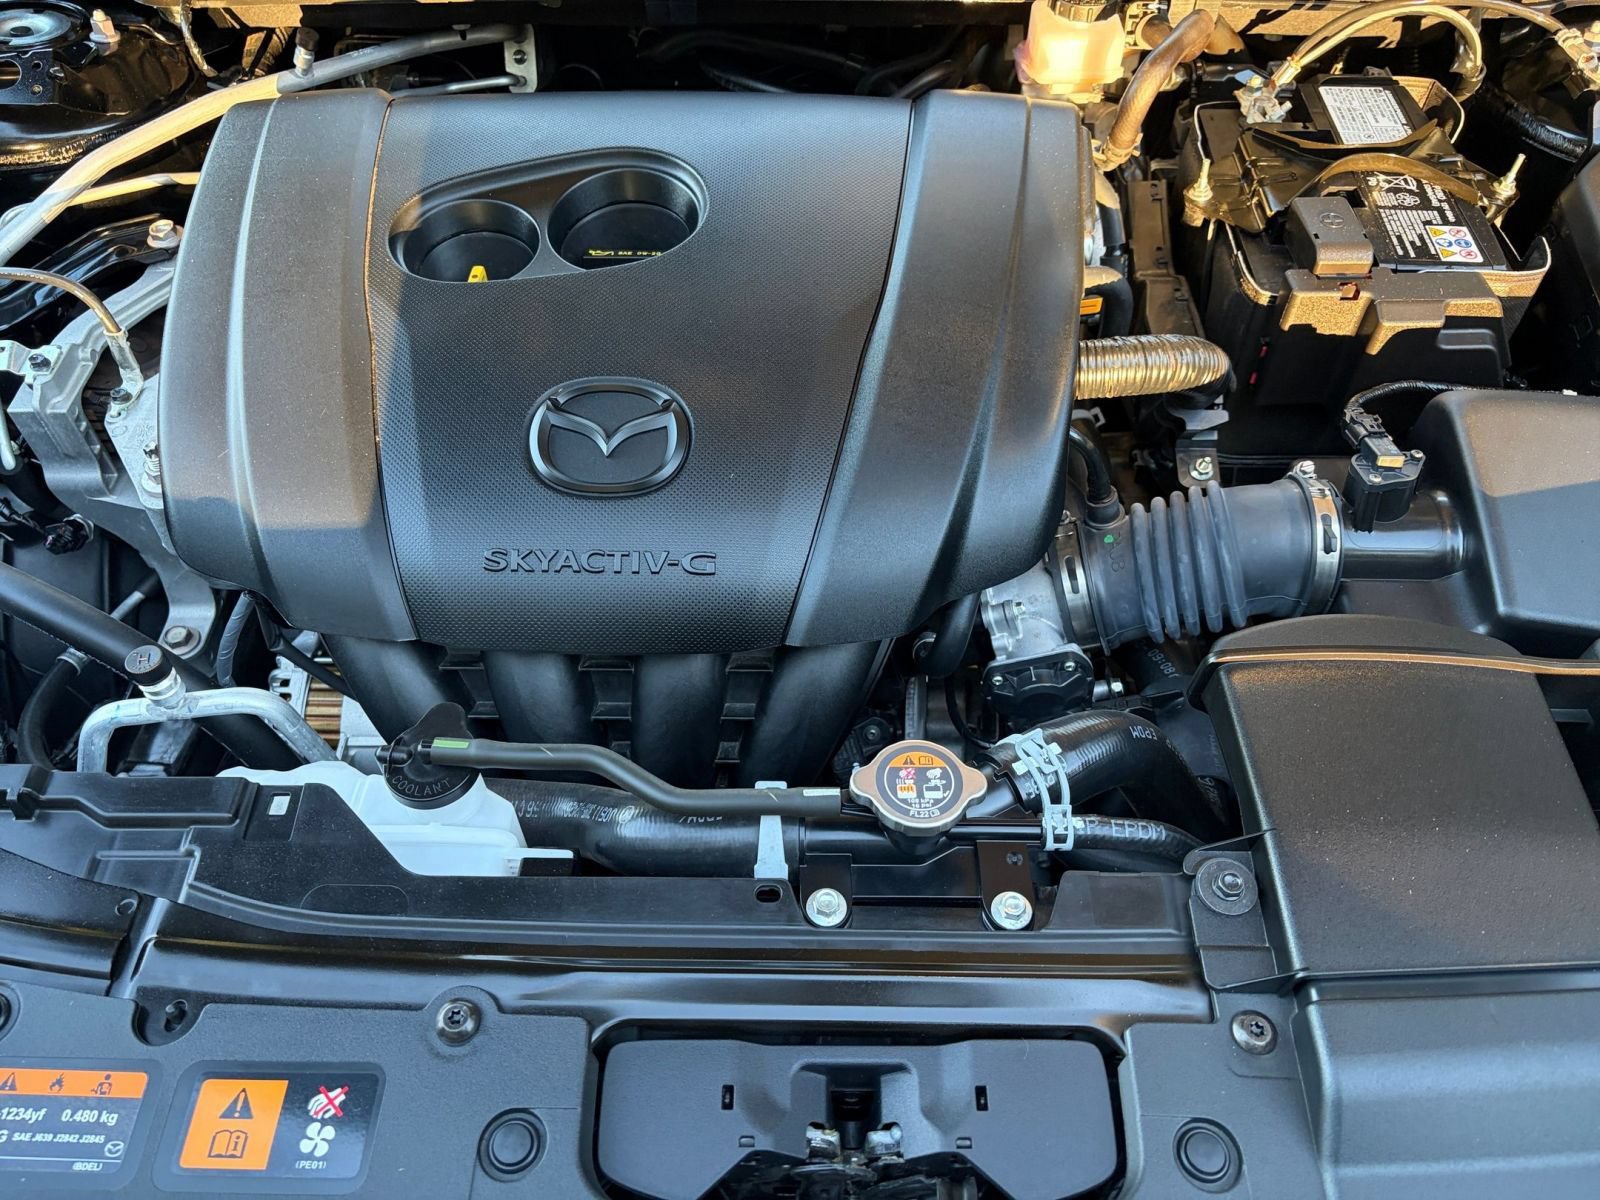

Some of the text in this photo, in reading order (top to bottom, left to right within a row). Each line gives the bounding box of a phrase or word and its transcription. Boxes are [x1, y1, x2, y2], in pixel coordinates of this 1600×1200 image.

[483, 548, 717, 576] SKYACTIV-G
[392, 776, 451, 796] COOLANT
[1111, 819, 1166, 841] EPDM
[0, 1107, 118, 1126] 1234yf 0.480 kg
[12, 1132, 32, 1142] SAE
[295, 1160, 327, 1169] (PE01)
